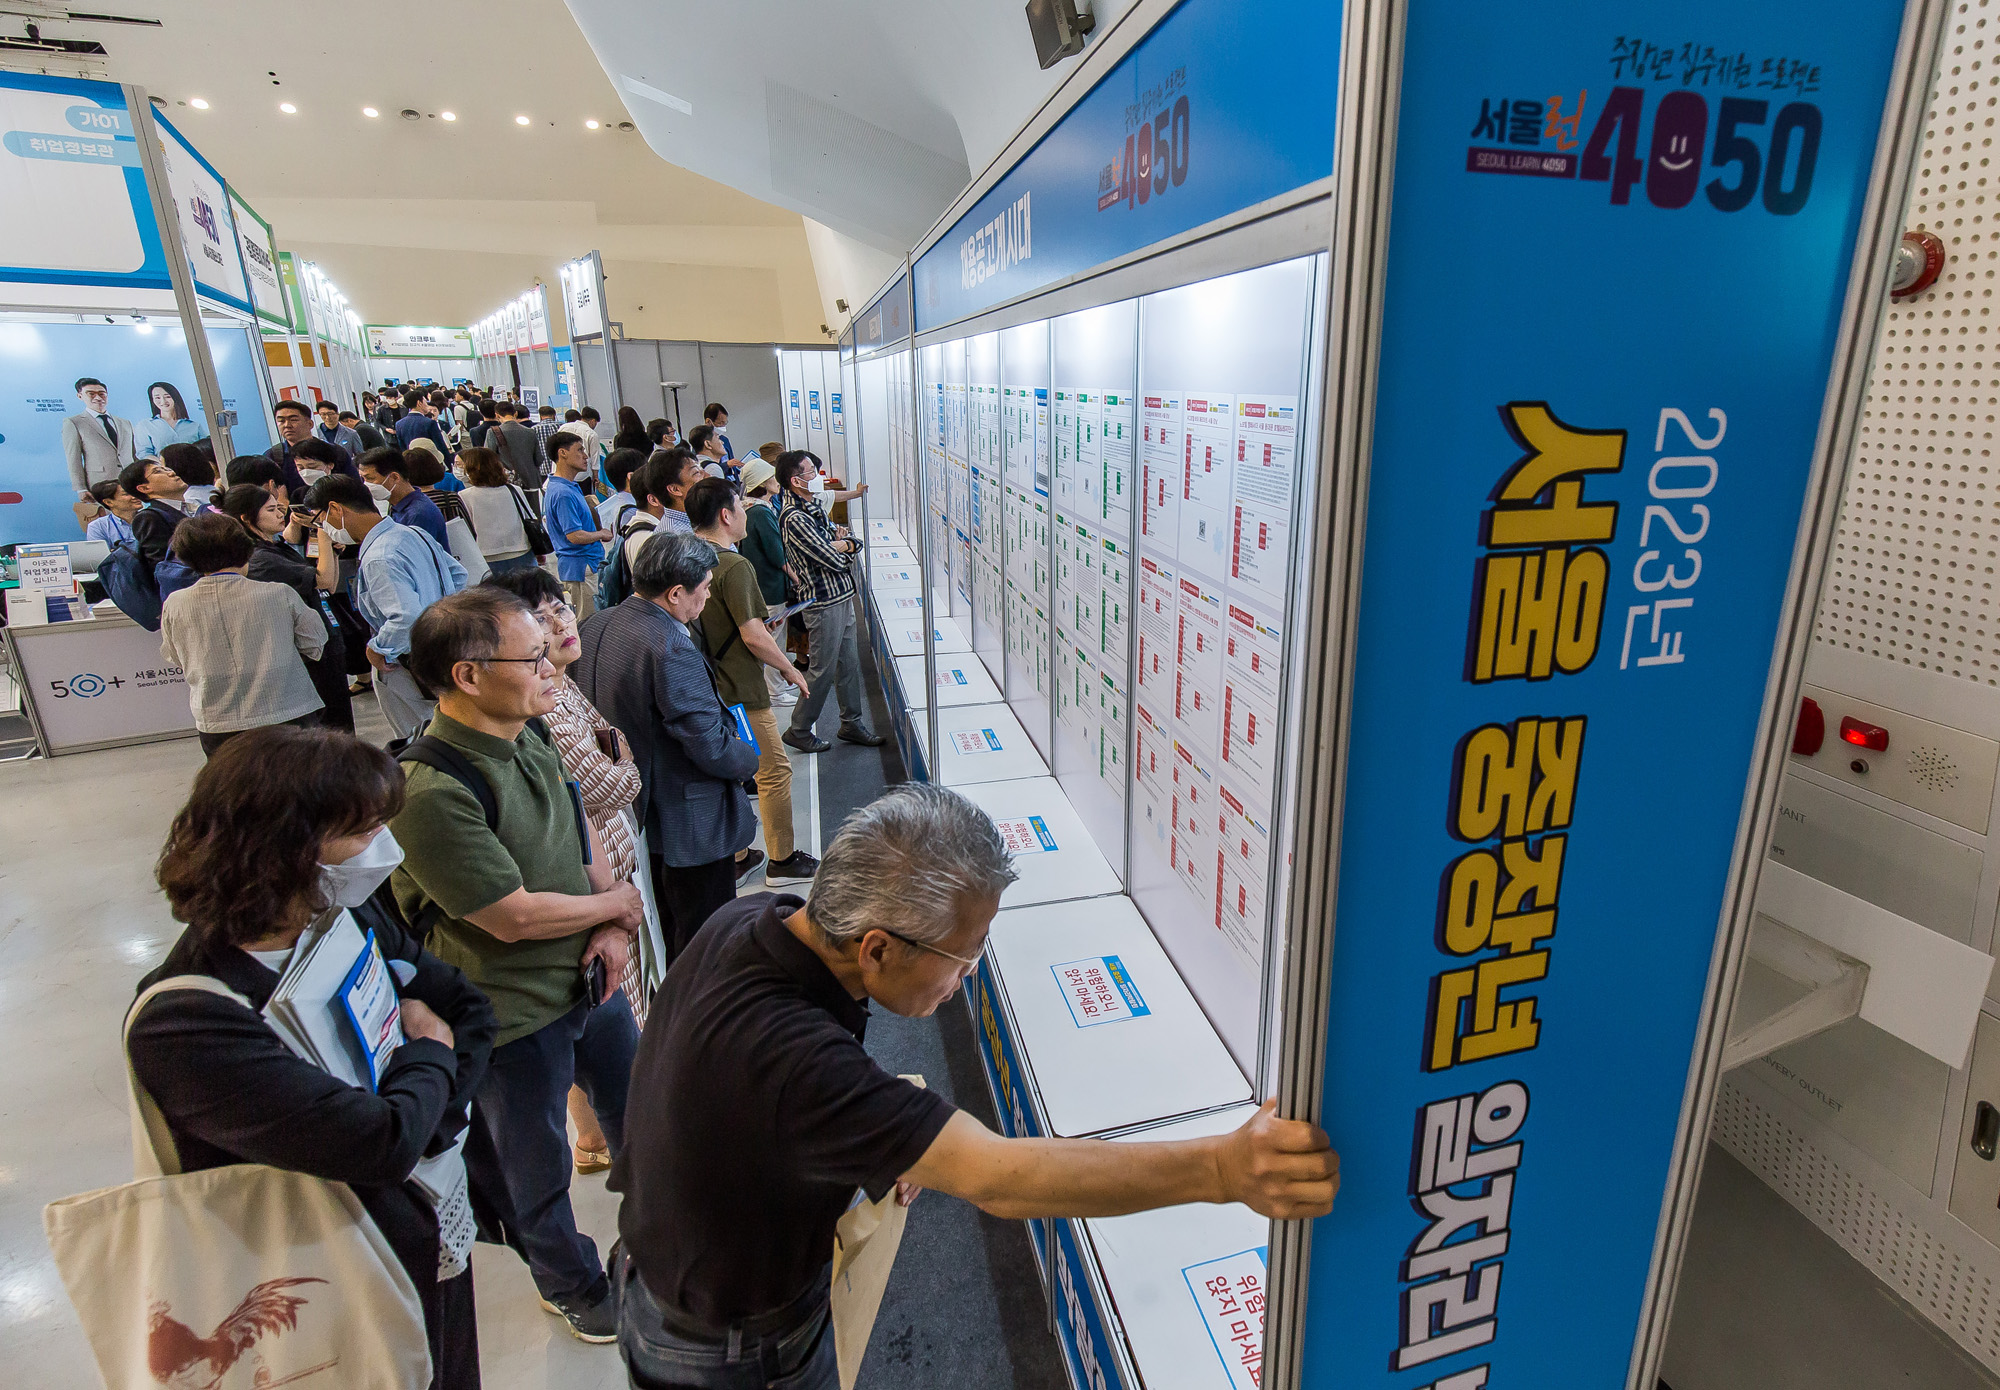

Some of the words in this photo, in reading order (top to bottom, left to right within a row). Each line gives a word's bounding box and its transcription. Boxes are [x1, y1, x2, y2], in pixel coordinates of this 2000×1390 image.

[79, 111, 120, 130] 가01
[29, 137, 115, 158] 취업정보관
[1121, 94, 1190, 211] 4050
[1471, 89, 1587, 151] 서울런
[1579, 86, 1823, 216] 4050
[1476, 152, 1508, 169] SEOUL
[1541, 157, 1567, 173] 4050
[960, 190, 1032, 290] 채용공고게시대
[409, 335, 436, 343] 인크루트
[1466, 401, 1628, 684] 서울
[1619, 407, 1728, 671] 2023년
[23, 566, 68, 576] 취업정보관
[32, 559, 57, 567] 이곳은
[137, 680, 158, 688] Seoul
[1014, 822, 1036, 849] 위험하오니
[1423, 714, 1588, 1073] 중장년
[1064, 968, 1086, 987] 앉지
[1075, 987, 1101, 1018] 마세요!
[1085, 968, 1119, 1012] 위험하오니
[1799, 1079, 1843, 1112] OUTLET
[1205, 1276, 1241, 1316] 앉지
